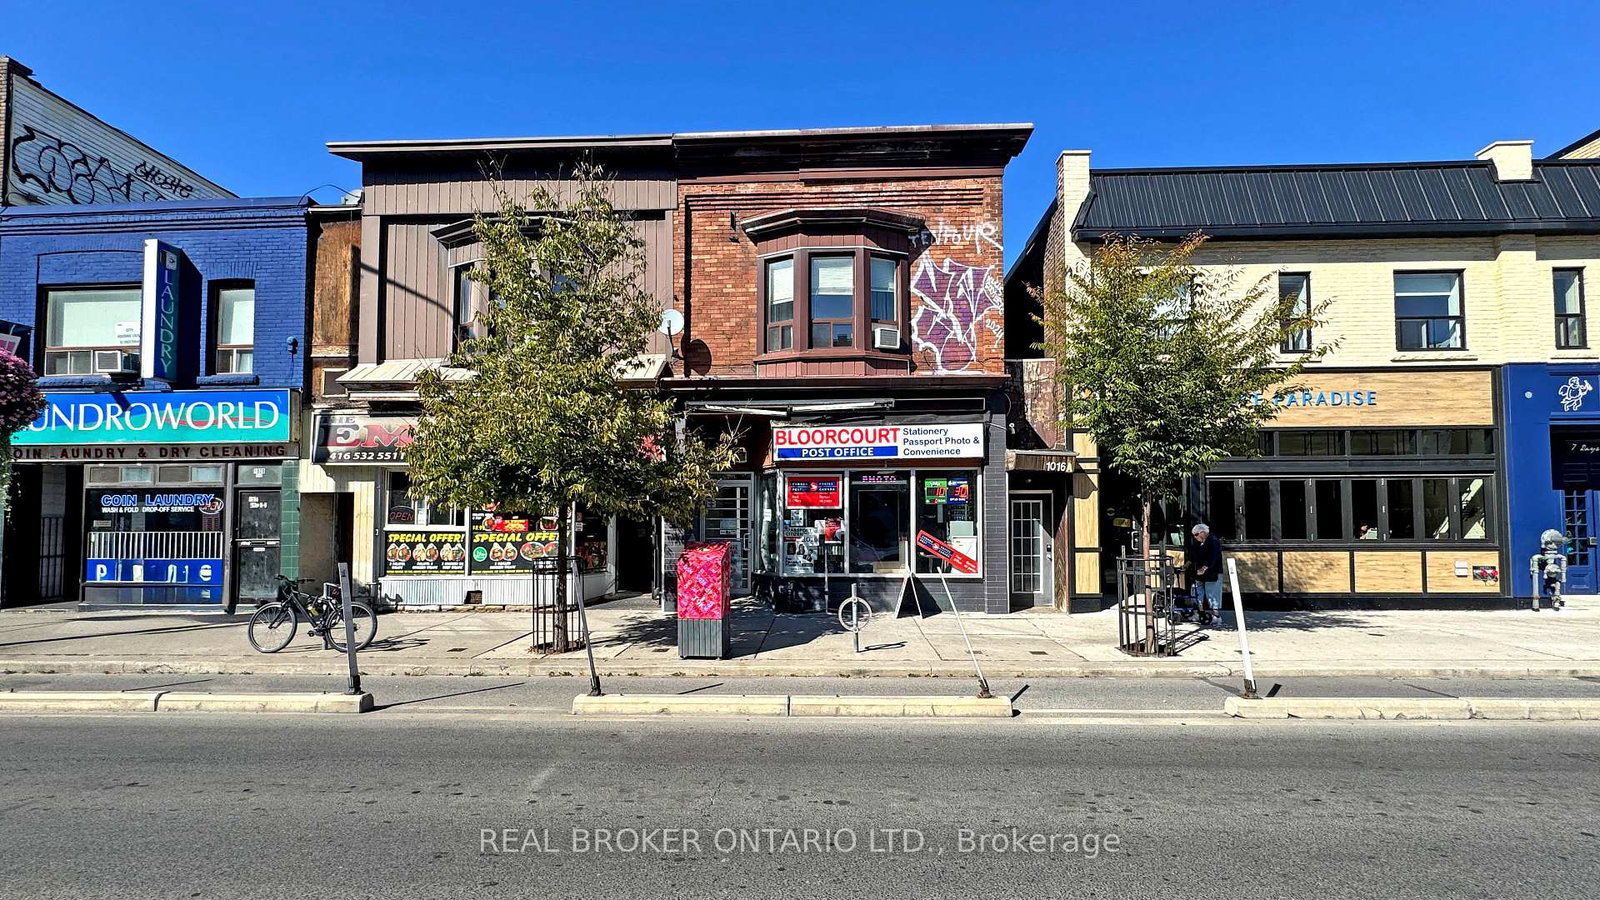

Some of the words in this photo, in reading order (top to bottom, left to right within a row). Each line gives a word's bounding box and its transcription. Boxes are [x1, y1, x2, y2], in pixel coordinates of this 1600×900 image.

[160, 269, 174, 373] LAUNDRY
[29, 401, 280, 432] UNDROWORLD
[775, 428, 900, 445] BLOORCOURT
[903, 427, 948, 436] Stationery
[903, 438, 943, 447] Passport
[945, 437, 970, 445] Photo
[13, 449, 41, 459] OIN
[51, 448, 126, 458] AUNDRY
[138, 448, 147, 458] &
[160, 447, 190, 457] DRY
[200, 446, 285, 456] CLEANING
[329, 452, 350, 460] 416
[353, 452, 374, 460] 532
[802, 449, 835, 457] POST
[839, 447, 874, 456] OFFICE
[903, 447, 961, 456] Convenience
[1046, 461, 1073, 473] 1016A
[101, 494, 137, 507] COIN
[145, 494, 214, 506] LAUNDRY
[389, 511, 414, 521] OPEN
[388, 533, 427, 543] SPECIAL
[429, 533, 465, 542] OFFER!
[472, 533, 522, 543] SPECIAL
[525, 532, 559, 542] OFFE
